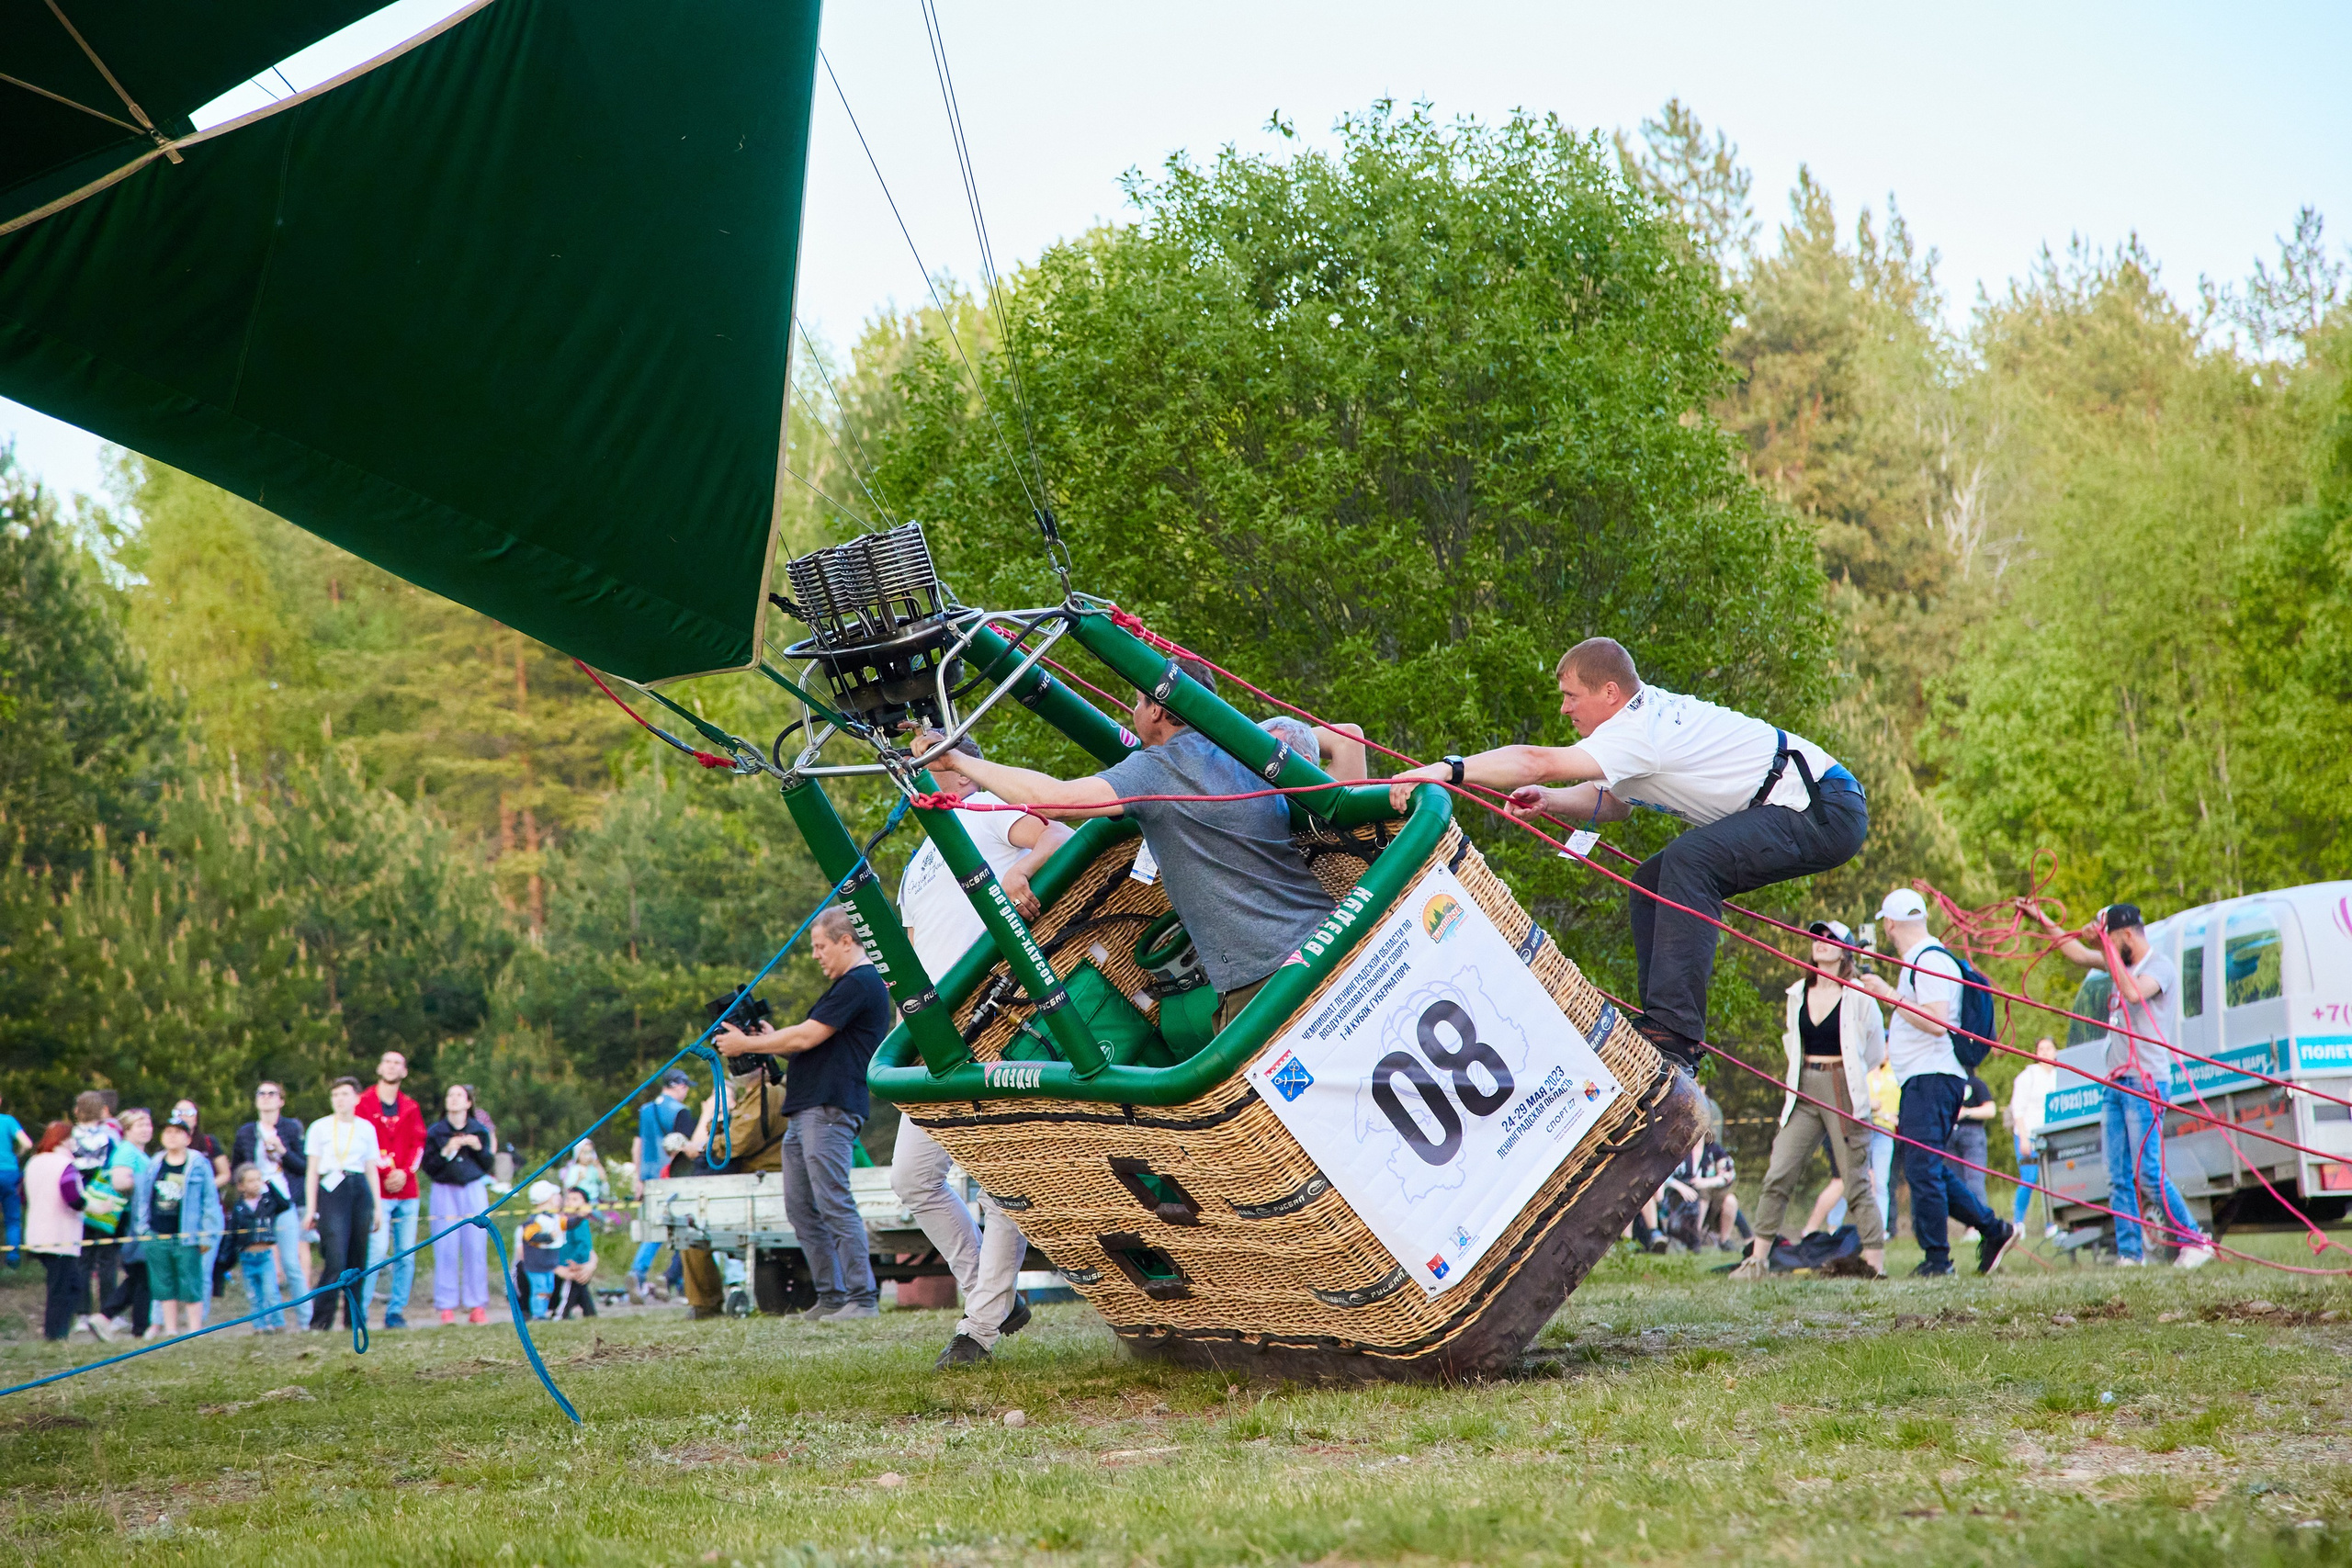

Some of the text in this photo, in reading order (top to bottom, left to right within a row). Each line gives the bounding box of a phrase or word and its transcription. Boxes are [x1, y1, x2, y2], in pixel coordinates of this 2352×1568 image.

[1305, 886, 1374, 956] ВОЗДУХ
[1302, 919, 1413, 1040] ЧЕМПИОНАТ ЛЕНИНГРАДСКОЙ ОБЛАСТИ ПО
[1318, 938, 1410, 1041] ВОЗДУХОПЛАВАТЕЛЬНОМУ СПОРТУ
[1340, 962, 1411, 1041] 1-Й КУБОК ГУБЕРНАТОРА
[993, 1068, 1042, 1089] ВОЗДУХ
[1372, 999, 1515, 1167] 08
[1501, 1102, 1528, 1133] 24-29
[1525, 1086, 1548, 1109] МАЯ
[1544, 1065, 1565, 1091] 2023
[1497, 1102, 1546, 1160] ЛЕНИНГРАДСКАЯ
[1544, 1077, 1574, 1108] ОБЛАСТЬ
[1545, 1106, 1569, 1134] СПОРТ
[1272, 1195, 1305, 1213] РУСБАЛ
